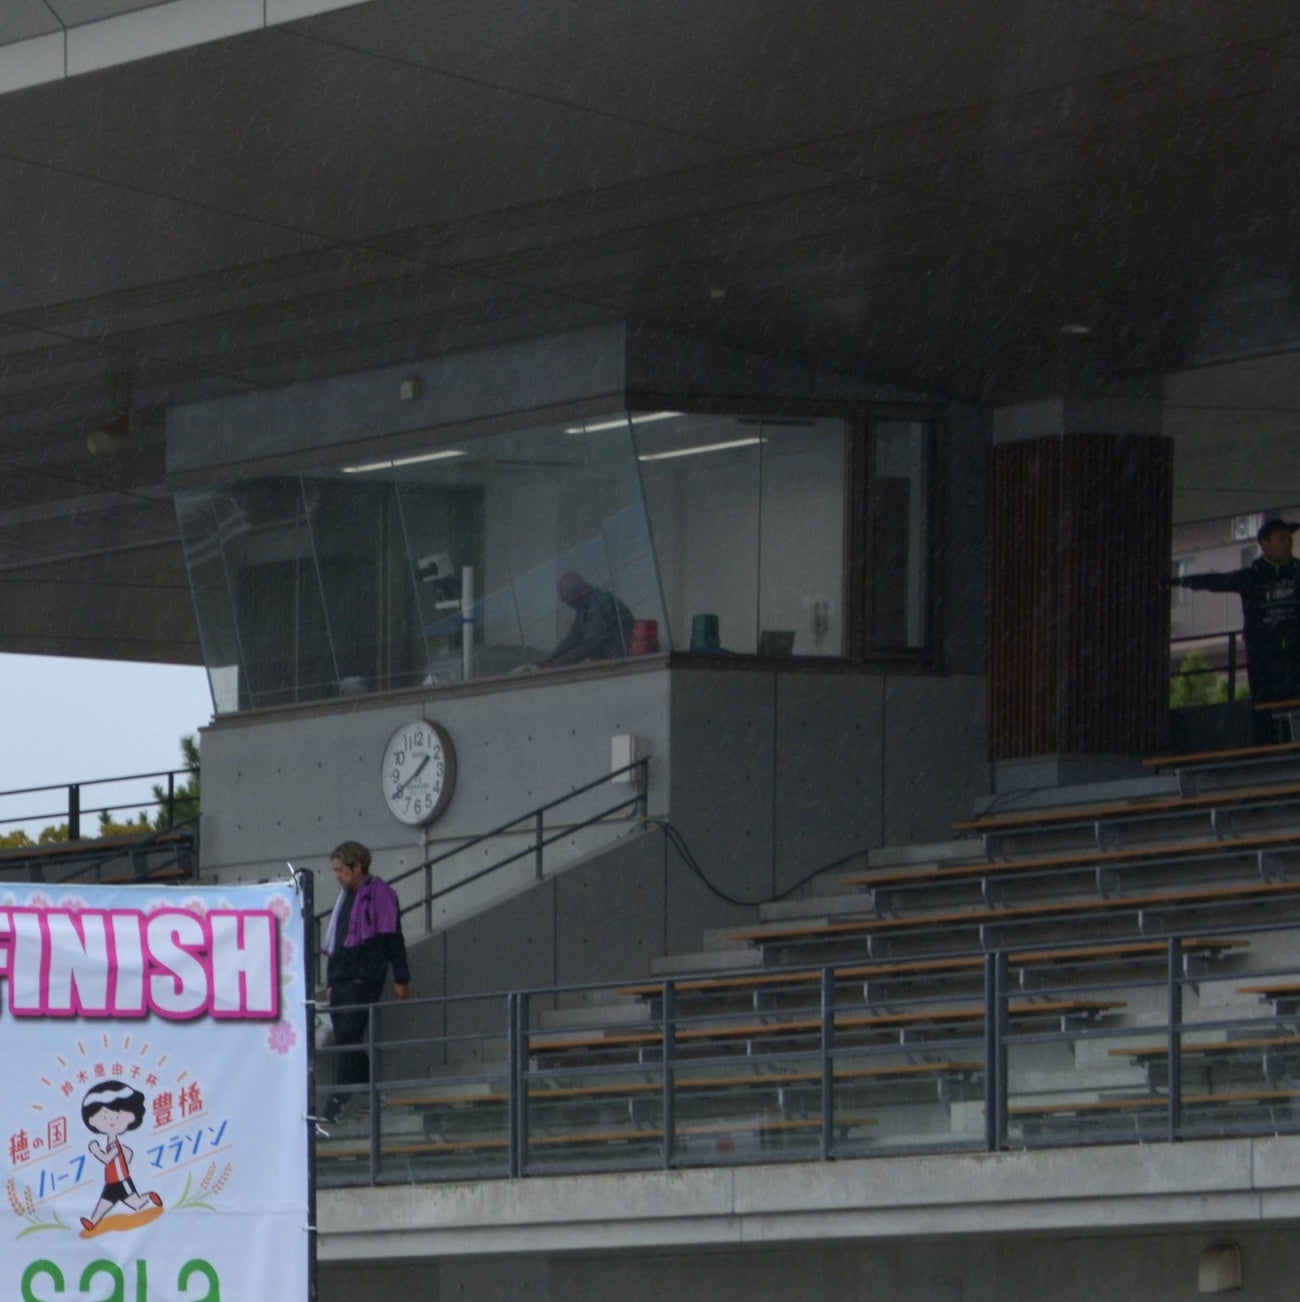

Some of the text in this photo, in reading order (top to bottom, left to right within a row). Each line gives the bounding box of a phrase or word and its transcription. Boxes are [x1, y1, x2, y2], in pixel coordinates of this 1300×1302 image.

[403, 734, 412, 751] 11
[414, 731, 423, 746] 12
[427, 734, 431, 748] 1
[393, 751, 405, 766] 10
[433, 745, 441, 760] 2
[393, 768, 400, 783] 9
[437, 762, 444, 777] 3
[405, 797, 411, 812] 7
[414, 799, 421, 814] 6
[425, 793, 432, 808] 5
[60, 1061, 161, 1097] 鈴木亜由子杯
[9, 1081, 204, 1164] 穂の国 豊橋
[37, 1119, 229, 1198] ハーフ マラソン
